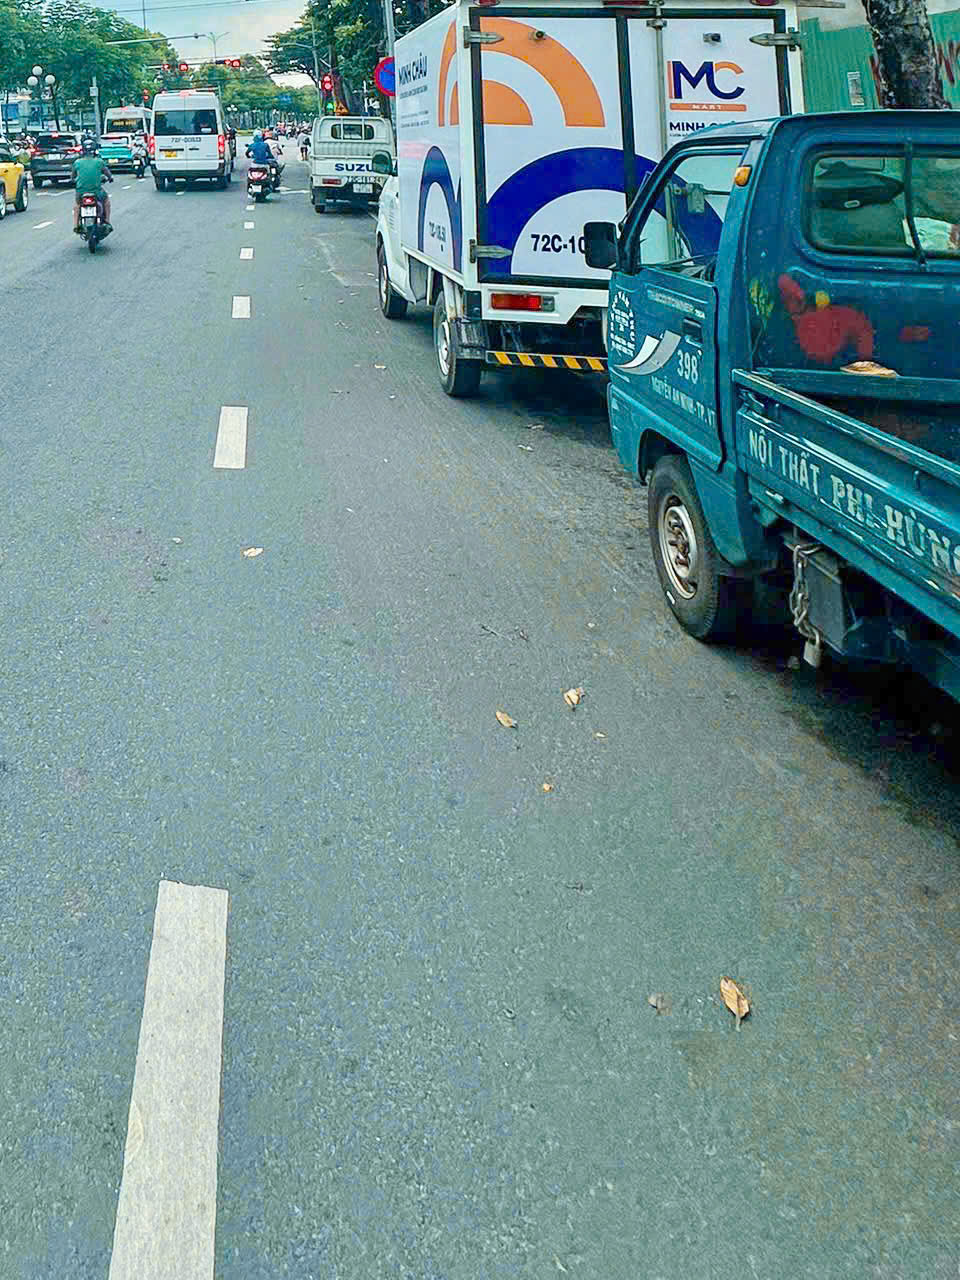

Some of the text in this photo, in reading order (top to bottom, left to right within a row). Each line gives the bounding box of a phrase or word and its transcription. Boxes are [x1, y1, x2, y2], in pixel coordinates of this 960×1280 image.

[669, 121, 705, 132] MINH
[677, 349, 699, 385] 398
[749, 429, 773, 468] NỘI
[779, 444, 820, 497] THẤT
